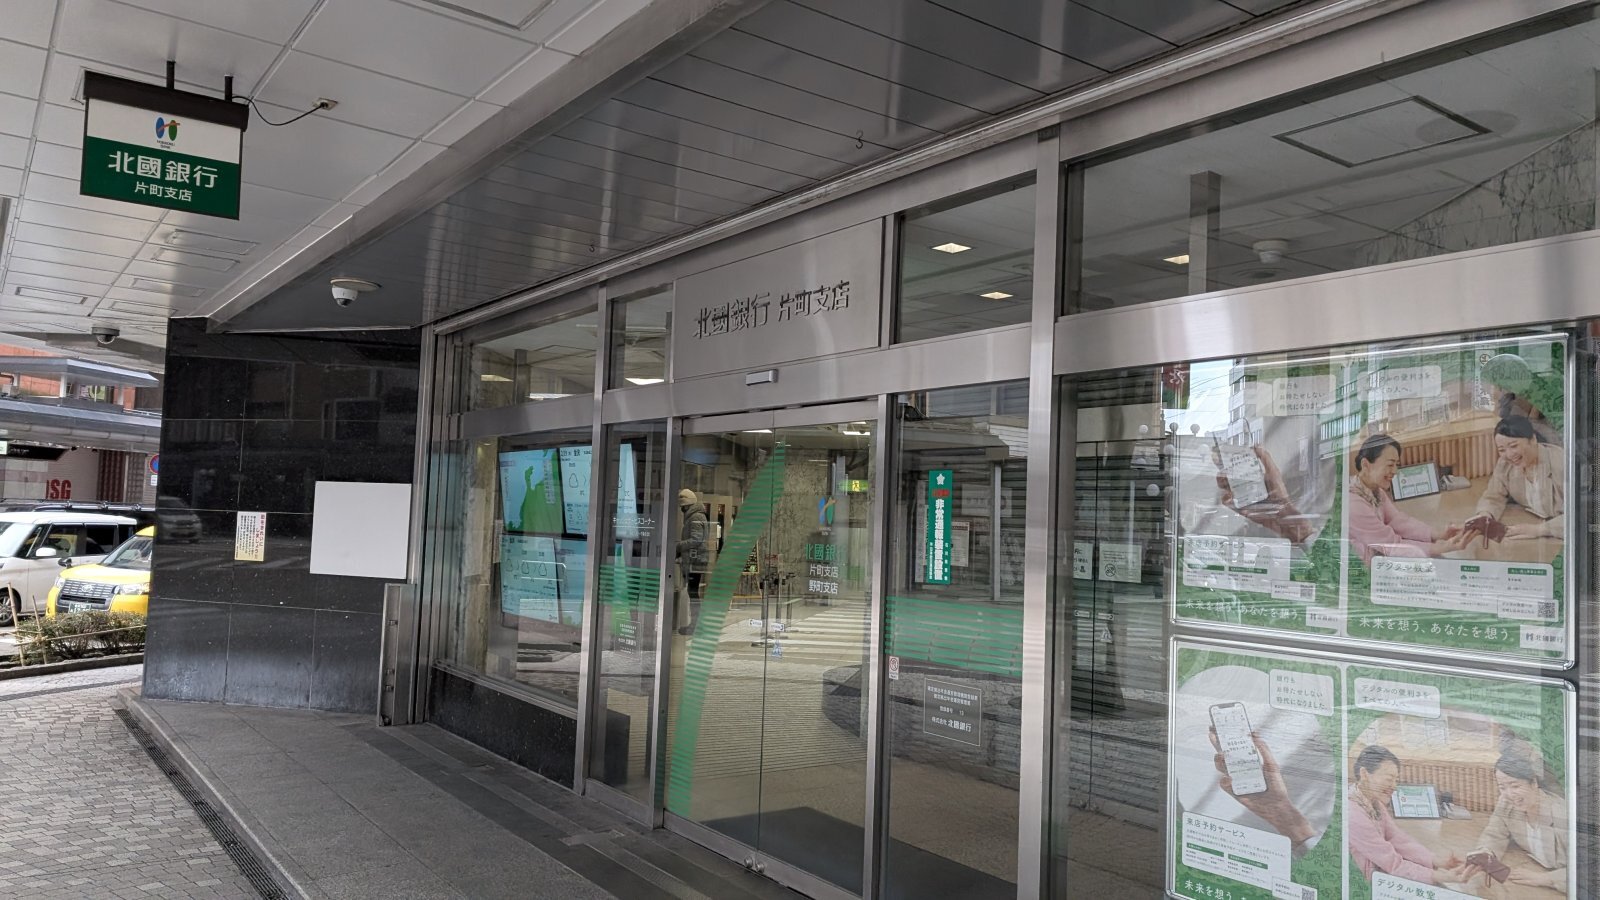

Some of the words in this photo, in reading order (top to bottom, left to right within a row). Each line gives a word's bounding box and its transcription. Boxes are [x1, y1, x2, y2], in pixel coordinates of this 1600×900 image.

[108, 150, 218, 188] 北國銀行
[134, 181, 193, 202] 片町支店
[692, 292, 770, 339] 北國銀行
[778, 280, 850, 322] 片町支店
[45, 478, 72, 500] SG
[810, 563, 839, 579] 片町支店
[809, 579, 839, 595] 野町支店
[1359, 617, 1514, 643] 未来を想う、あなたを想う。
[1186, 817, 1246, 839] 来店予約サービス
